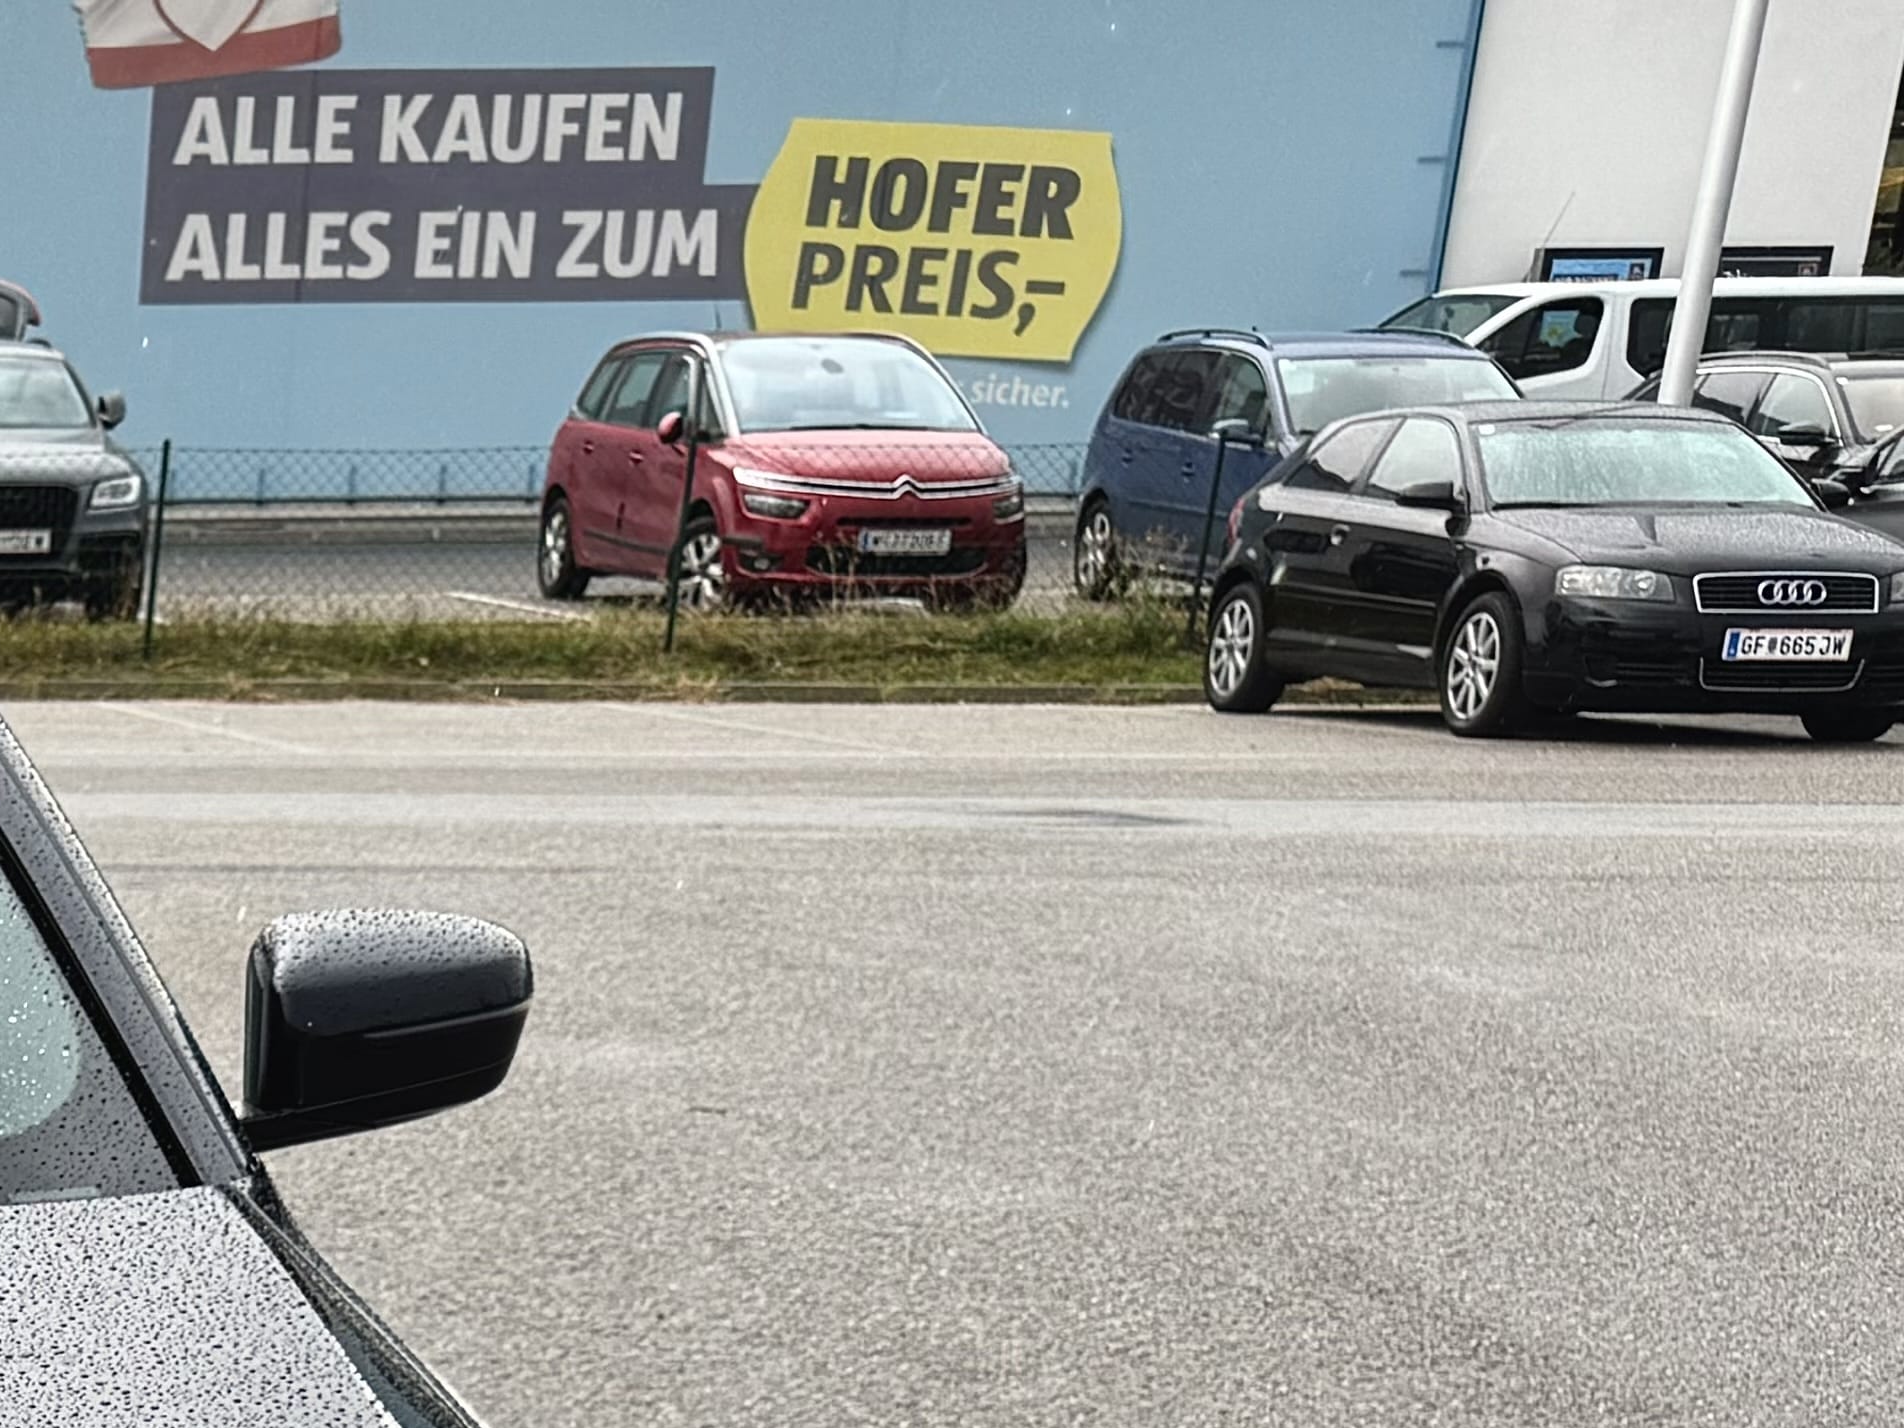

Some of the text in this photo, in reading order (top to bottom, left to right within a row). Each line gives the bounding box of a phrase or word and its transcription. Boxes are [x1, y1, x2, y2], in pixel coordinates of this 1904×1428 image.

[173, 92, 684, 165] ALLE KAUFEN
[805, 155, 1081, 240] HOFER
[164, 208, 719, 281] ALLES EIN ZUM
[971, 373, 1069, 408] sicher.
[1741, 636, 1766, 655] GF
